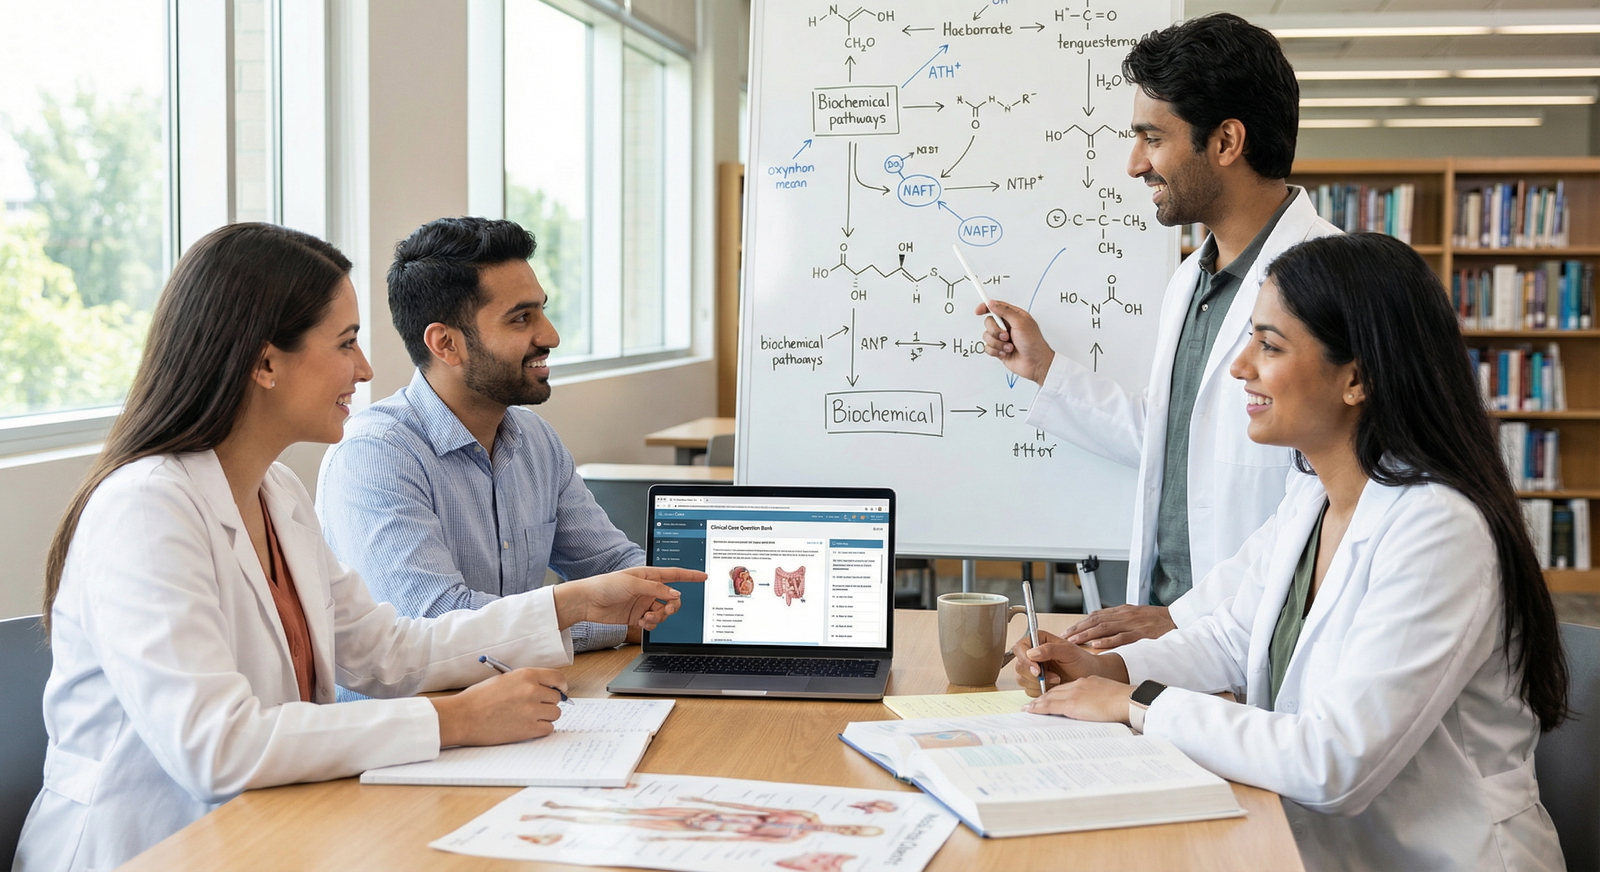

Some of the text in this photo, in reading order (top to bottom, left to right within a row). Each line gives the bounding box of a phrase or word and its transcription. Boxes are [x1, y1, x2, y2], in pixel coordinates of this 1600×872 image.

[818, 92, 889, 110] Biochemical
[830, 112, 886, 131] pathways
[903, 184, 936, 197] NAFT
[761, 335, 823, 350] biochemical
[833, 399, 933, 423] Biochemical
[739, 524, 761, 532] Question
